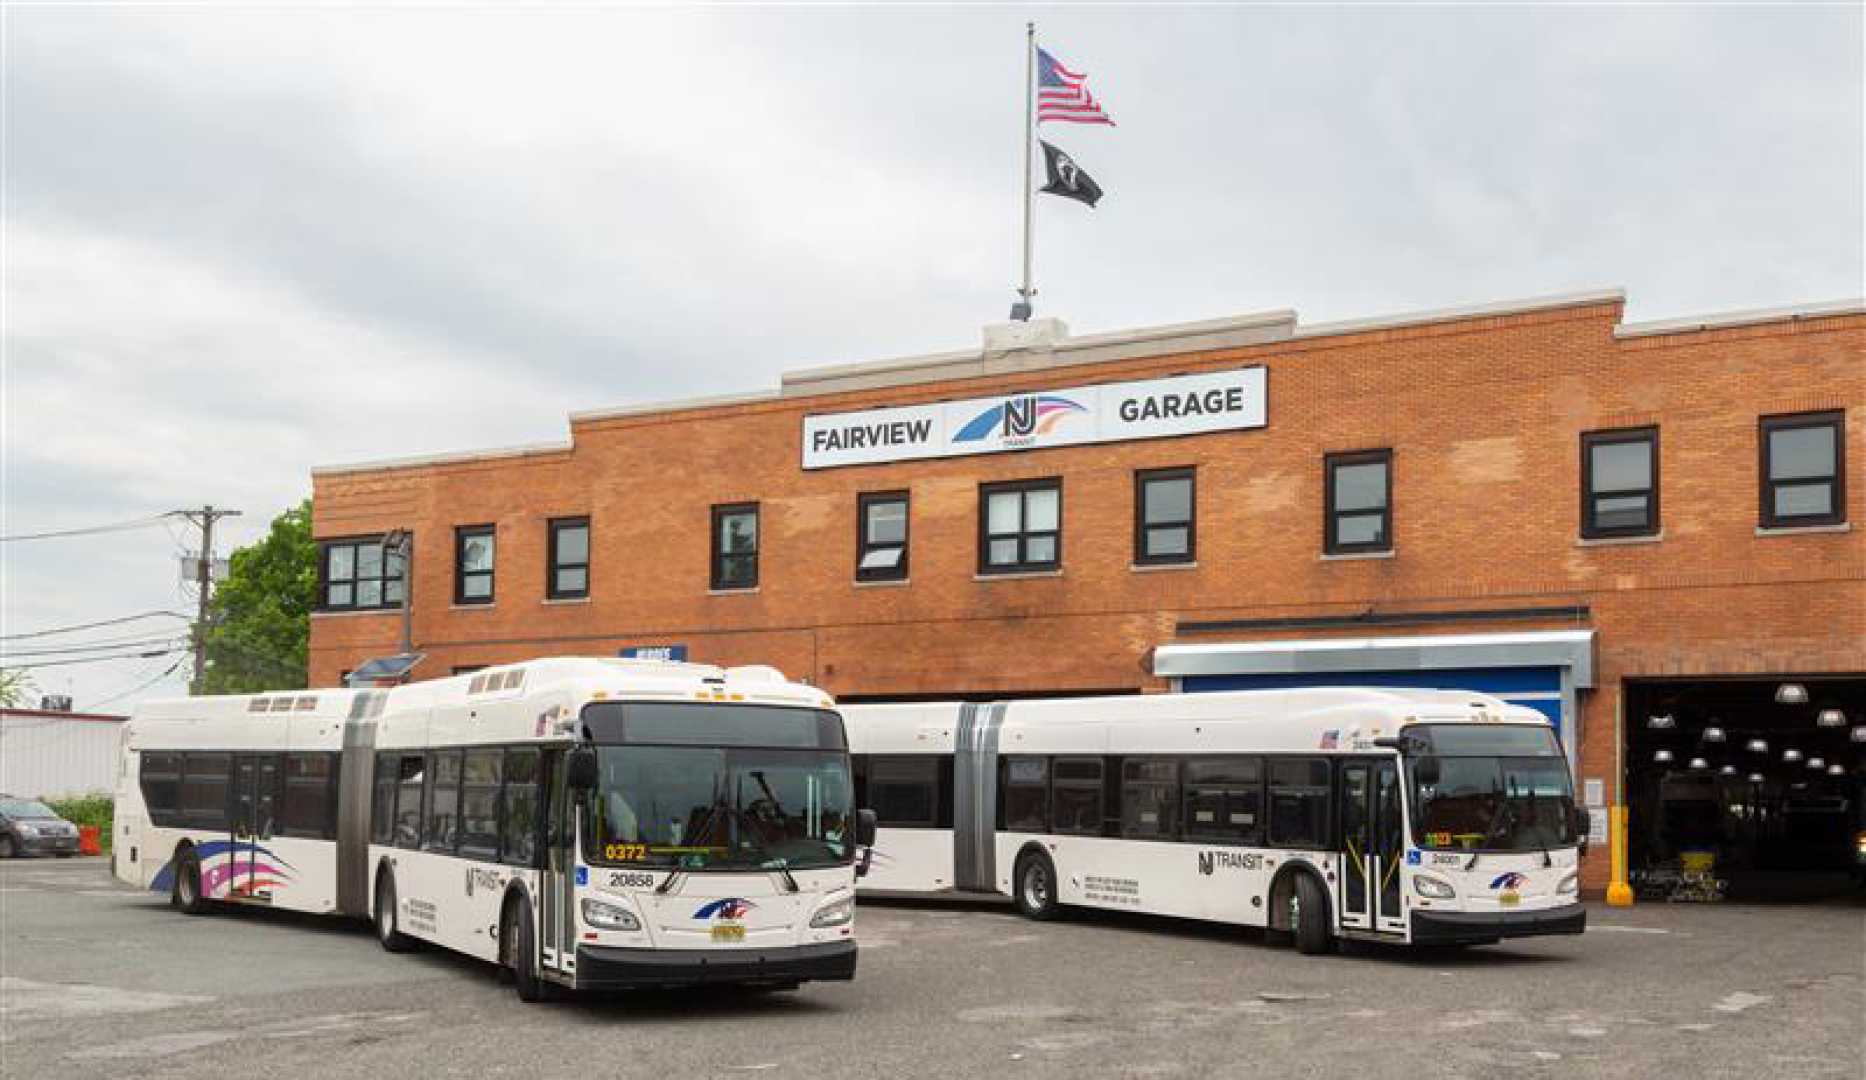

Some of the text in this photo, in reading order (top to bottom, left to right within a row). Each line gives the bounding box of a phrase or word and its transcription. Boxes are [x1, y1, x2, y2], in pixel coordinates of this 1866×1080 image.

[1005, 397, 1037, 436] NJ
[1120, 388, 1243, 422] GARAGE
[813, 419, 932, 452] FAIRVIEW
[1215, 851, 1263, 870] TRANSIT
